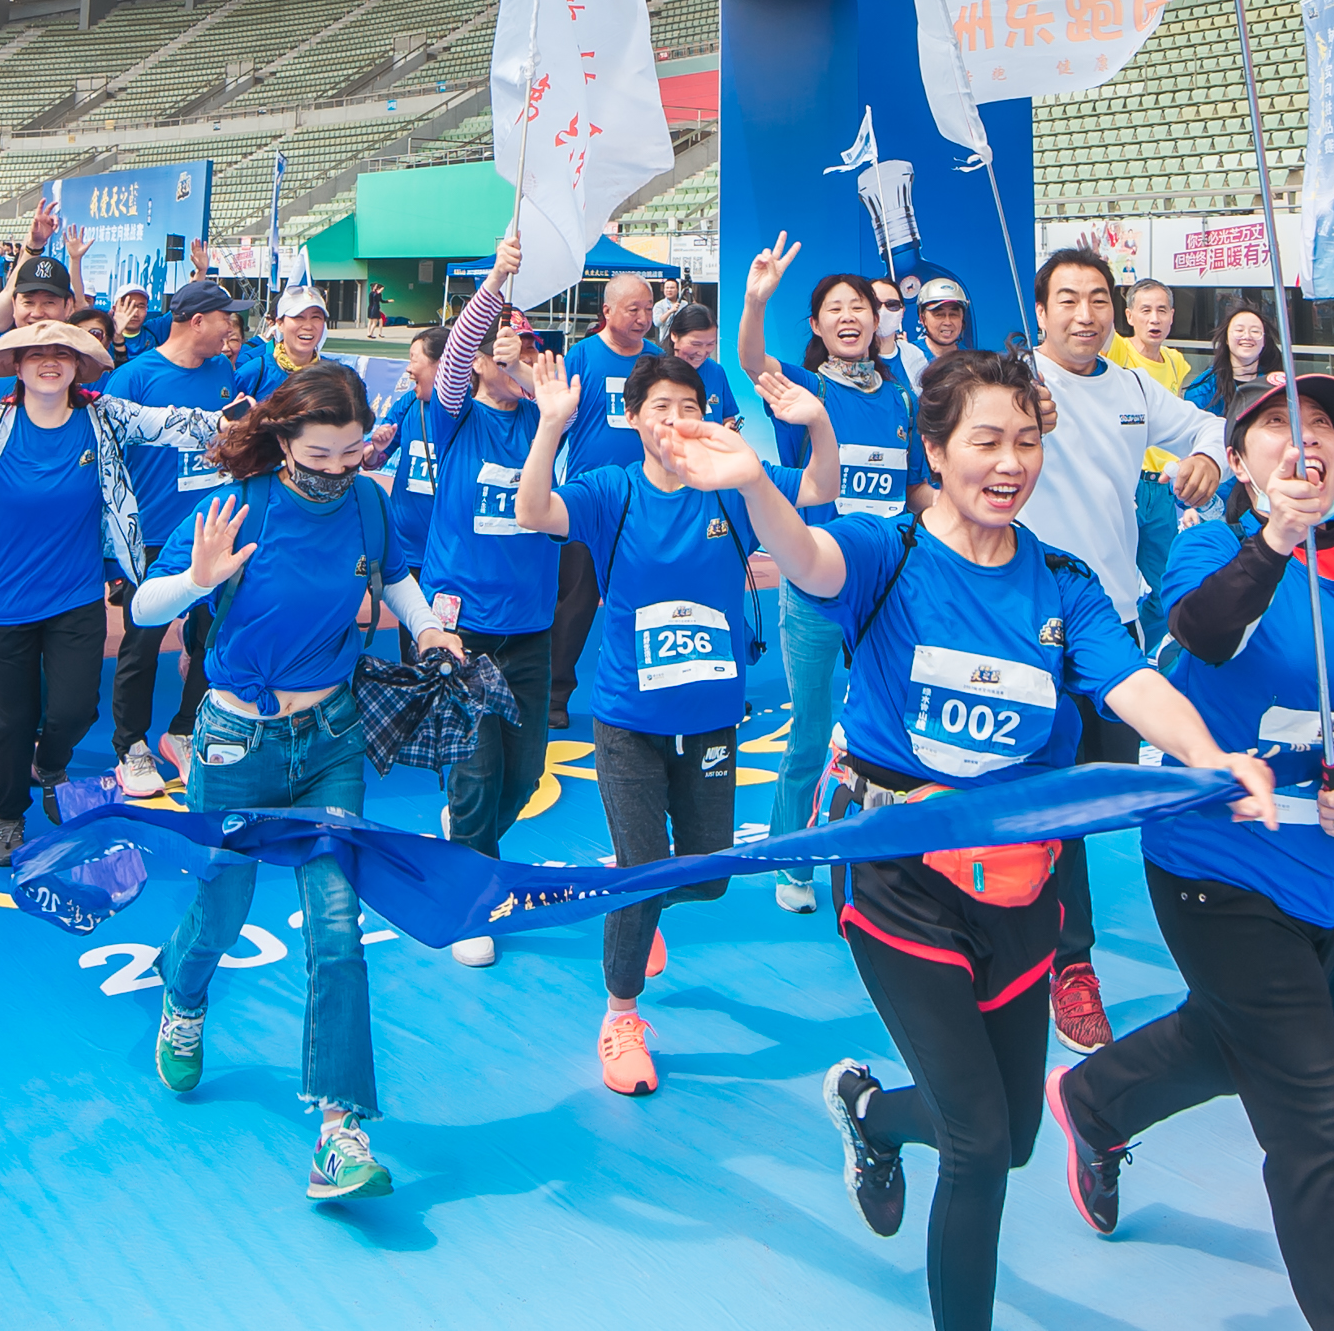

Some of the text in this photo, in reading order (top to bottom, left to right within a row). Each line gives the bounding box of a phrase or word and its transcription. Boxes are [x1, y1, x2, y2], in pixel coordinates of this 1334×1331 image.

[852, 471, 893, 495] 079
[657, 629, 713, 658] 256
[941, 698, 1021, 746] 002
[705, 745, 728, 761] NIKE
